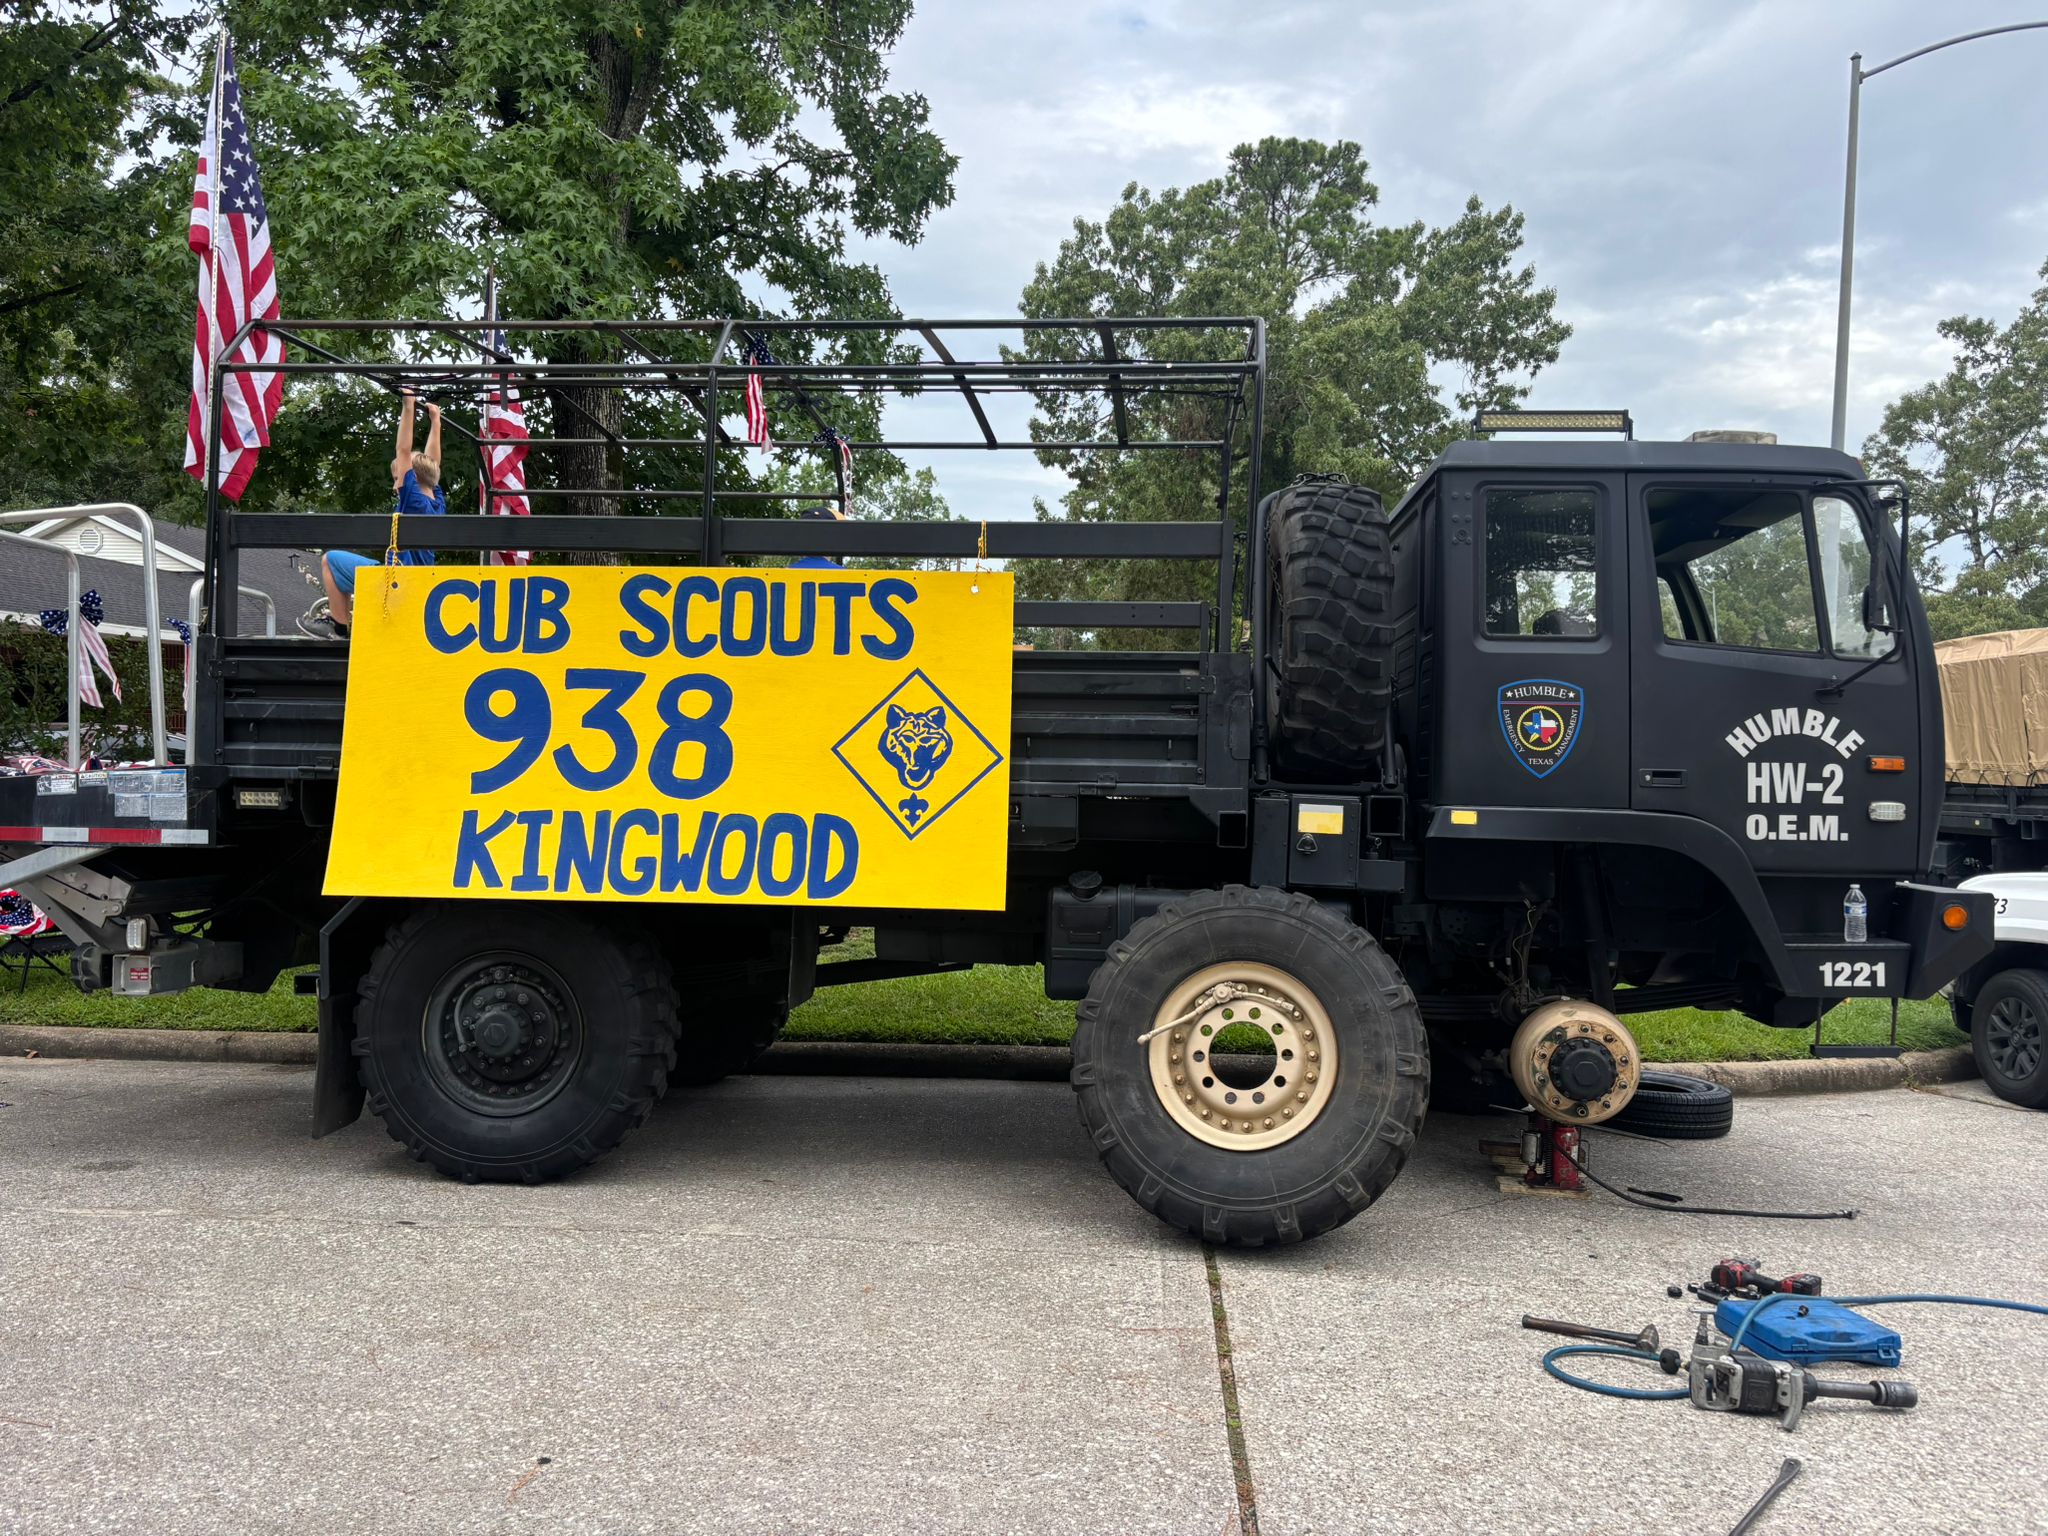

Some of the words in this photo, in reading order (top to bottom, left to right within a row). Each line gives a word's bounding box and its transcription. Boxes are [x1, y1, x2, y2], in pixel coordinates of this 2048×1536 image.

[425, 577, 571, 654] CUB
[620, 575, 919, 660] SCOUTS
[1514, 685, 1568, 699] HUMBLE
[464, 668, 733, 800] 938
[1503, 709, 1525, 753] EMERGENCY
[1554, 709, 1578, 757] MANAGEMENT
[1725, 707, 1866, 760] HUMBLE
[1528, 758, 1554, 766] TEXAS
[1747, 762, 1844, 805] HW-2
[1746, 813, 1849, 842] O.E.M.
[452, 808, 859, 900] KINGWOOD
[1819, 961, 1886, 987] 1221
